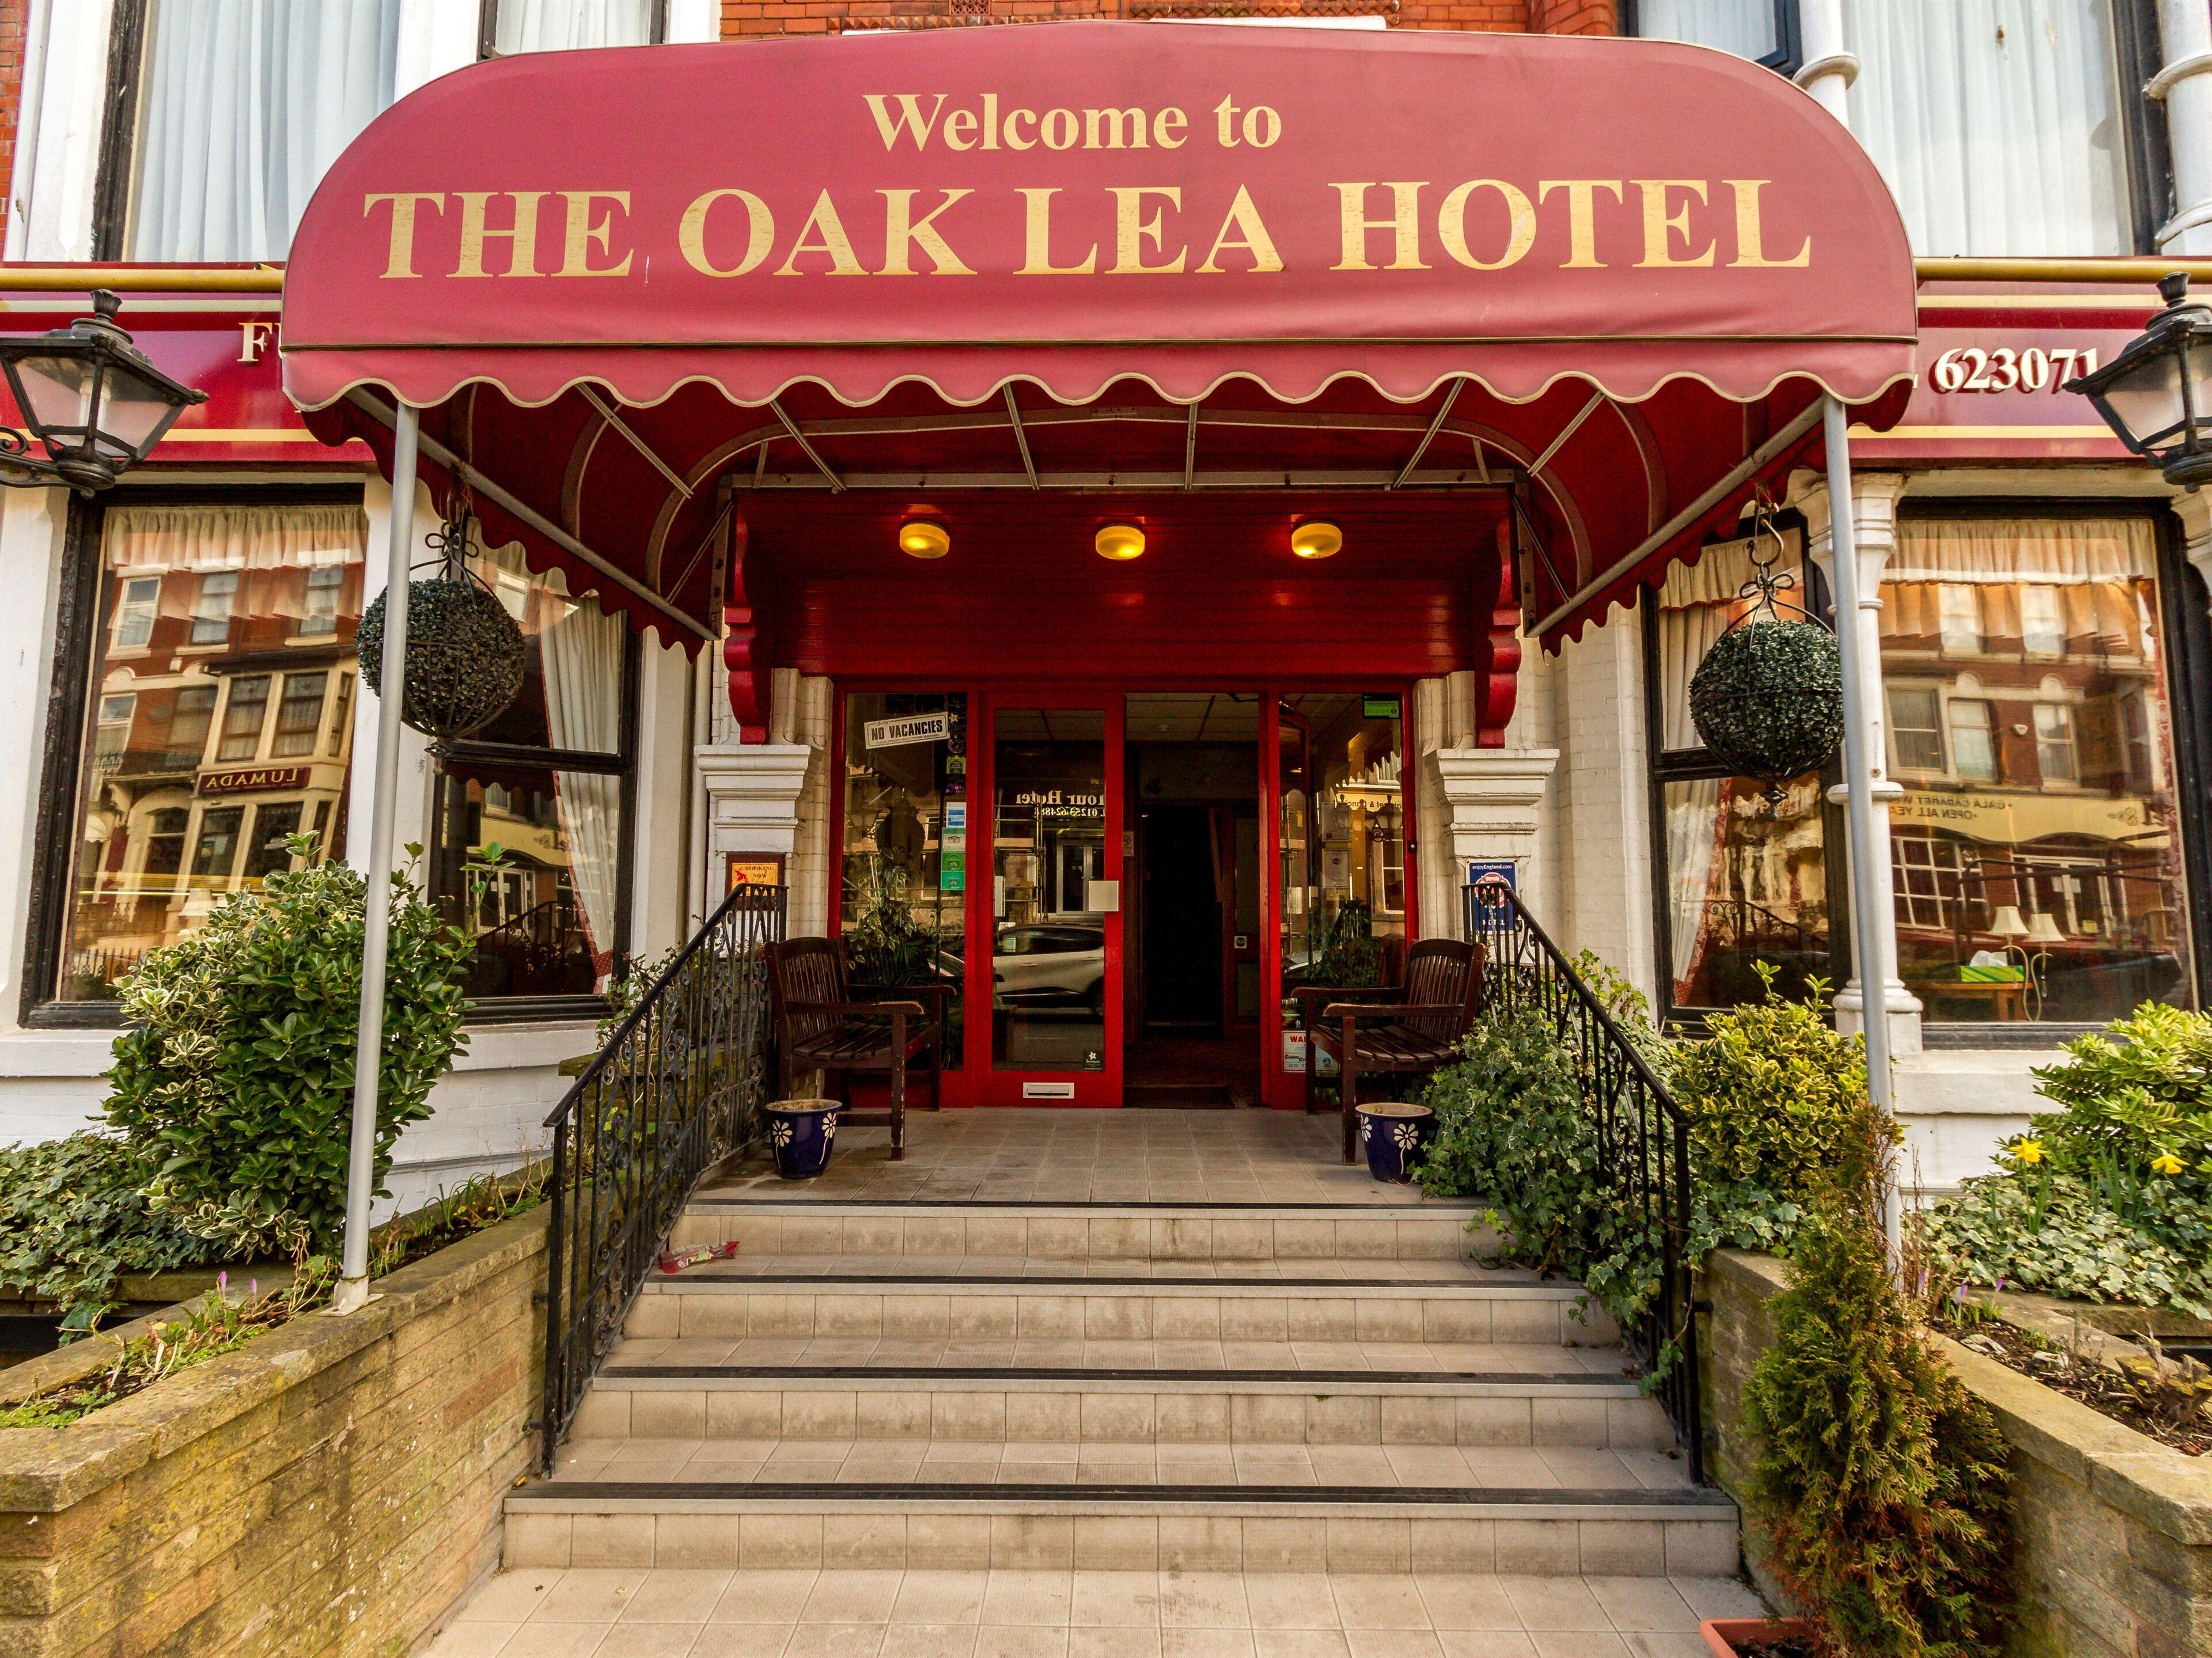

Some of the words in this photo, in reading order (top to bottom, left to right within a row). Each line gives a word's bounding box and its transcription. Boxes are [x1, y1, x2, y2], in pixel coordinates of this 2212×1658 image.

[863, 93, 1187, 151] Welcome
[1213, 94, 1281, 147] to
[364, 191, 633, 278] THE
[679, 189, 977, 277] OAK
[1013, 184, 1283, 274] LEA
[1328, 179, 1810, 270] HOTEL
[1935, 347, 2098, 390] 623071
[871, 727, 885, 741] NO
[889, 719, 943, 738] VACANCIES
